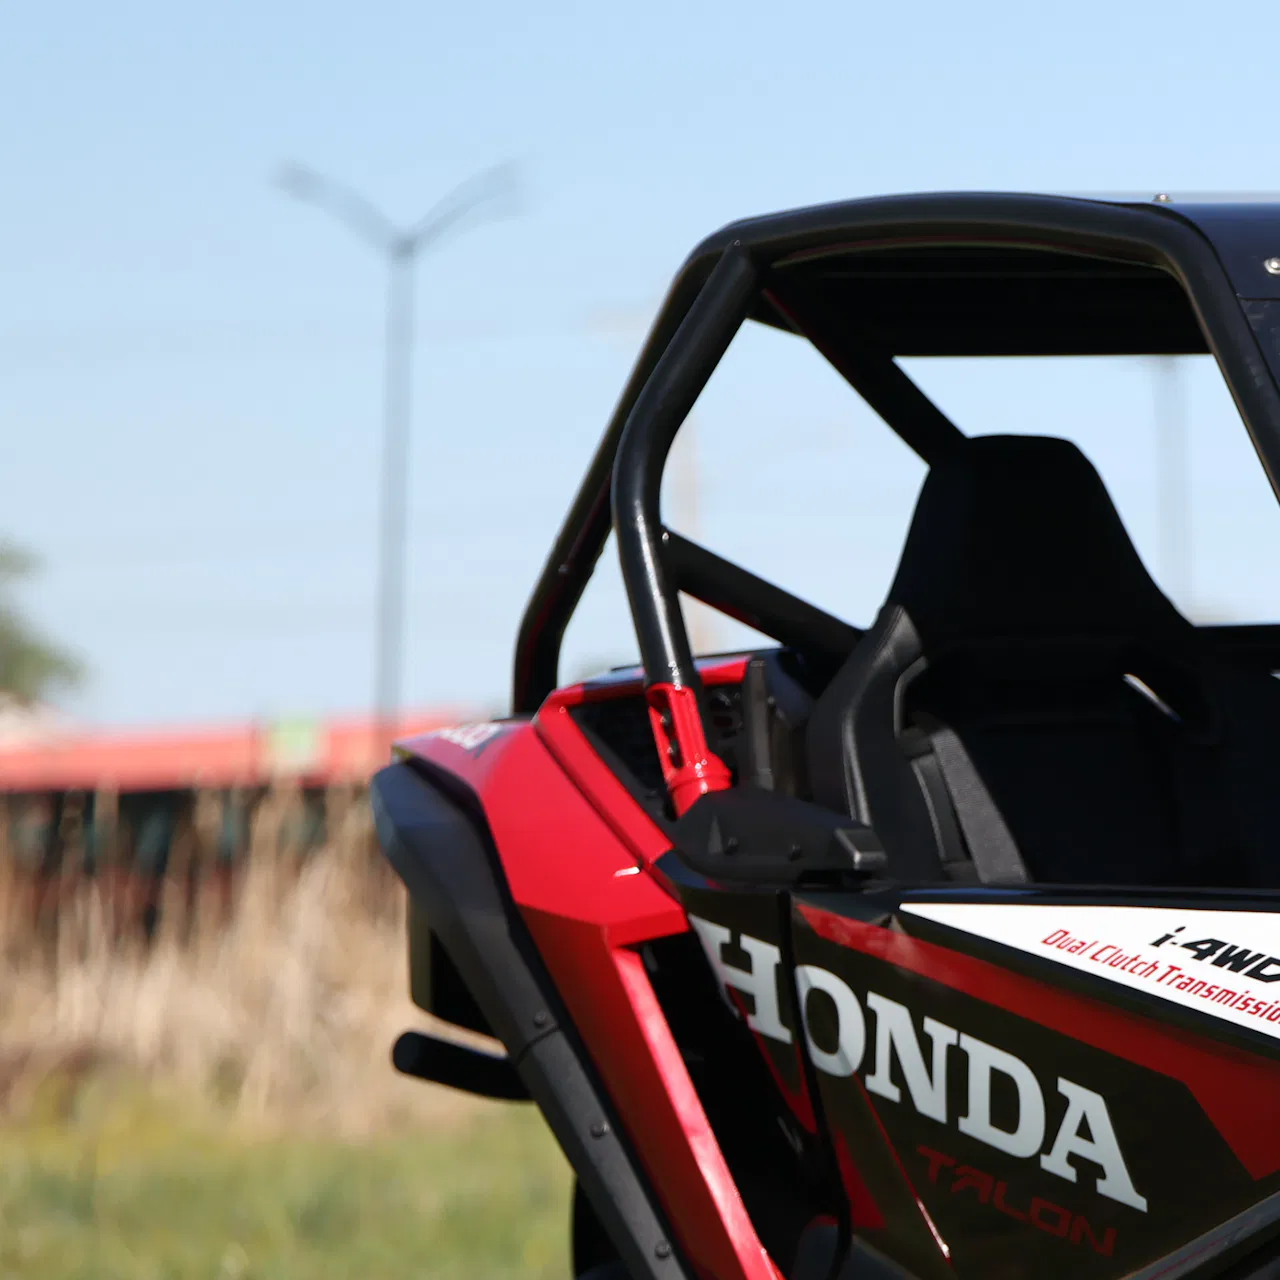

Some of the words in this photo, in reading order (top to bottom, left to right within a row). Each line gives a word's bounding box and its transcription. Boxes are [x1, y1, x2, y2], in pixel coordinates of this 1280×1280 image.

[1042, 929, 1091, 955] Dual
[1090, 945, 1159, 978] Clutch
[689, 914, 1148, 1212] HONDA
[916, 1144, 1117, 1257] TALON
